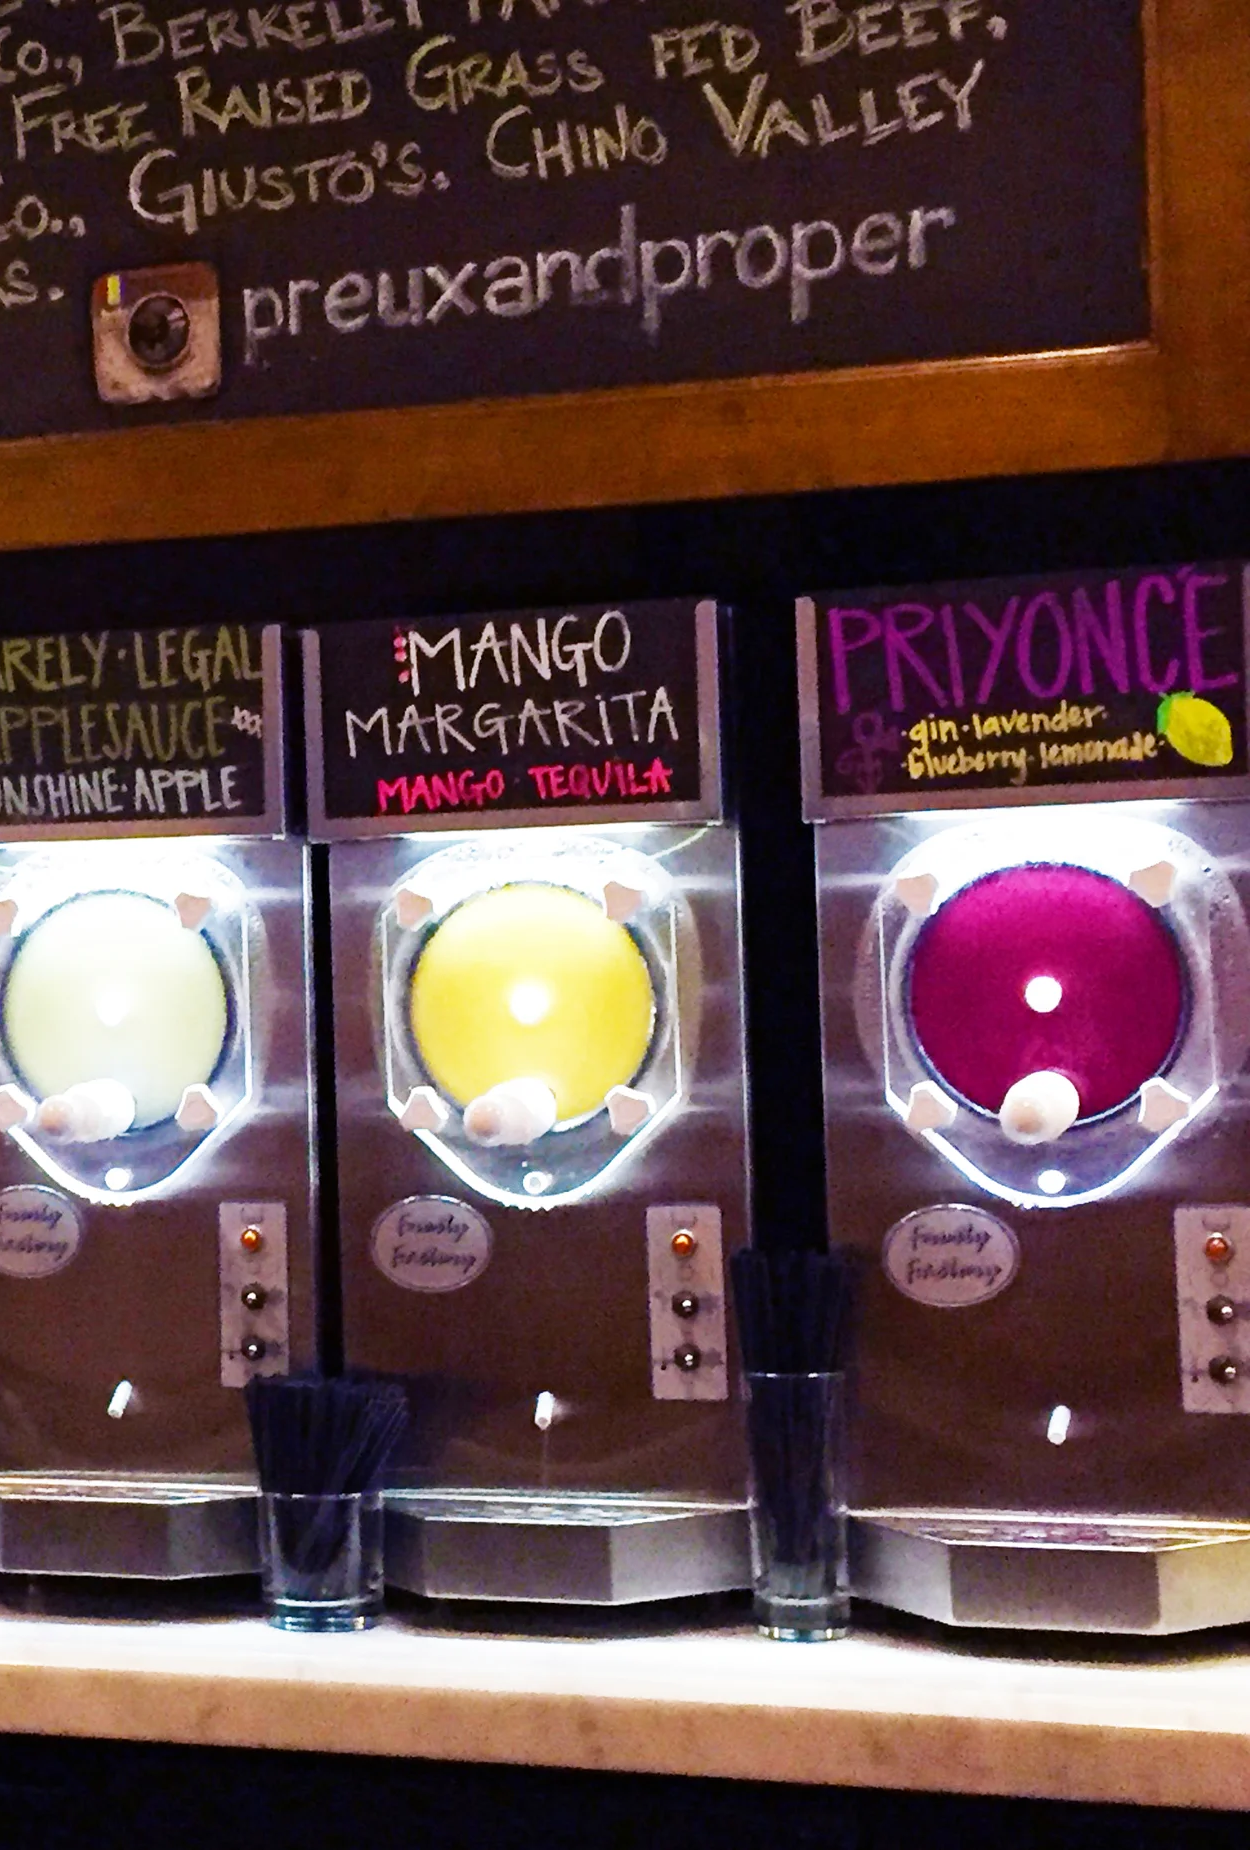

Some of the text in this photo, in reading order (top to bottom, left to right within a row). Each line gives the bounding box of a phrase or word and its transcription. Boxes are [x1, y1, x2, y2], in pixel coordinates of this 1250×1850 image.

[10, 83, 155, 162] FREE
[174, 66, 375, 137] RAISED
[405, 33, 606, 115] GRASS
[652, 20, 762, 80] FED
[485, 101, 669, 182] CHINO
[701, 57, 987, 160] VALLEY
[241, 202, 958, 370] preuxandproper
[133, 624, 264, 692] LEGAL
[407, 608, 632, 698] MANGO
[907, 730, 1158, 787] blueberry lemonade
[908, 699, 1105, 752] gin lavender
[132, 765, 242, 815] APPLE
[377, 757, 674, 815] MANGO TEQUILA
